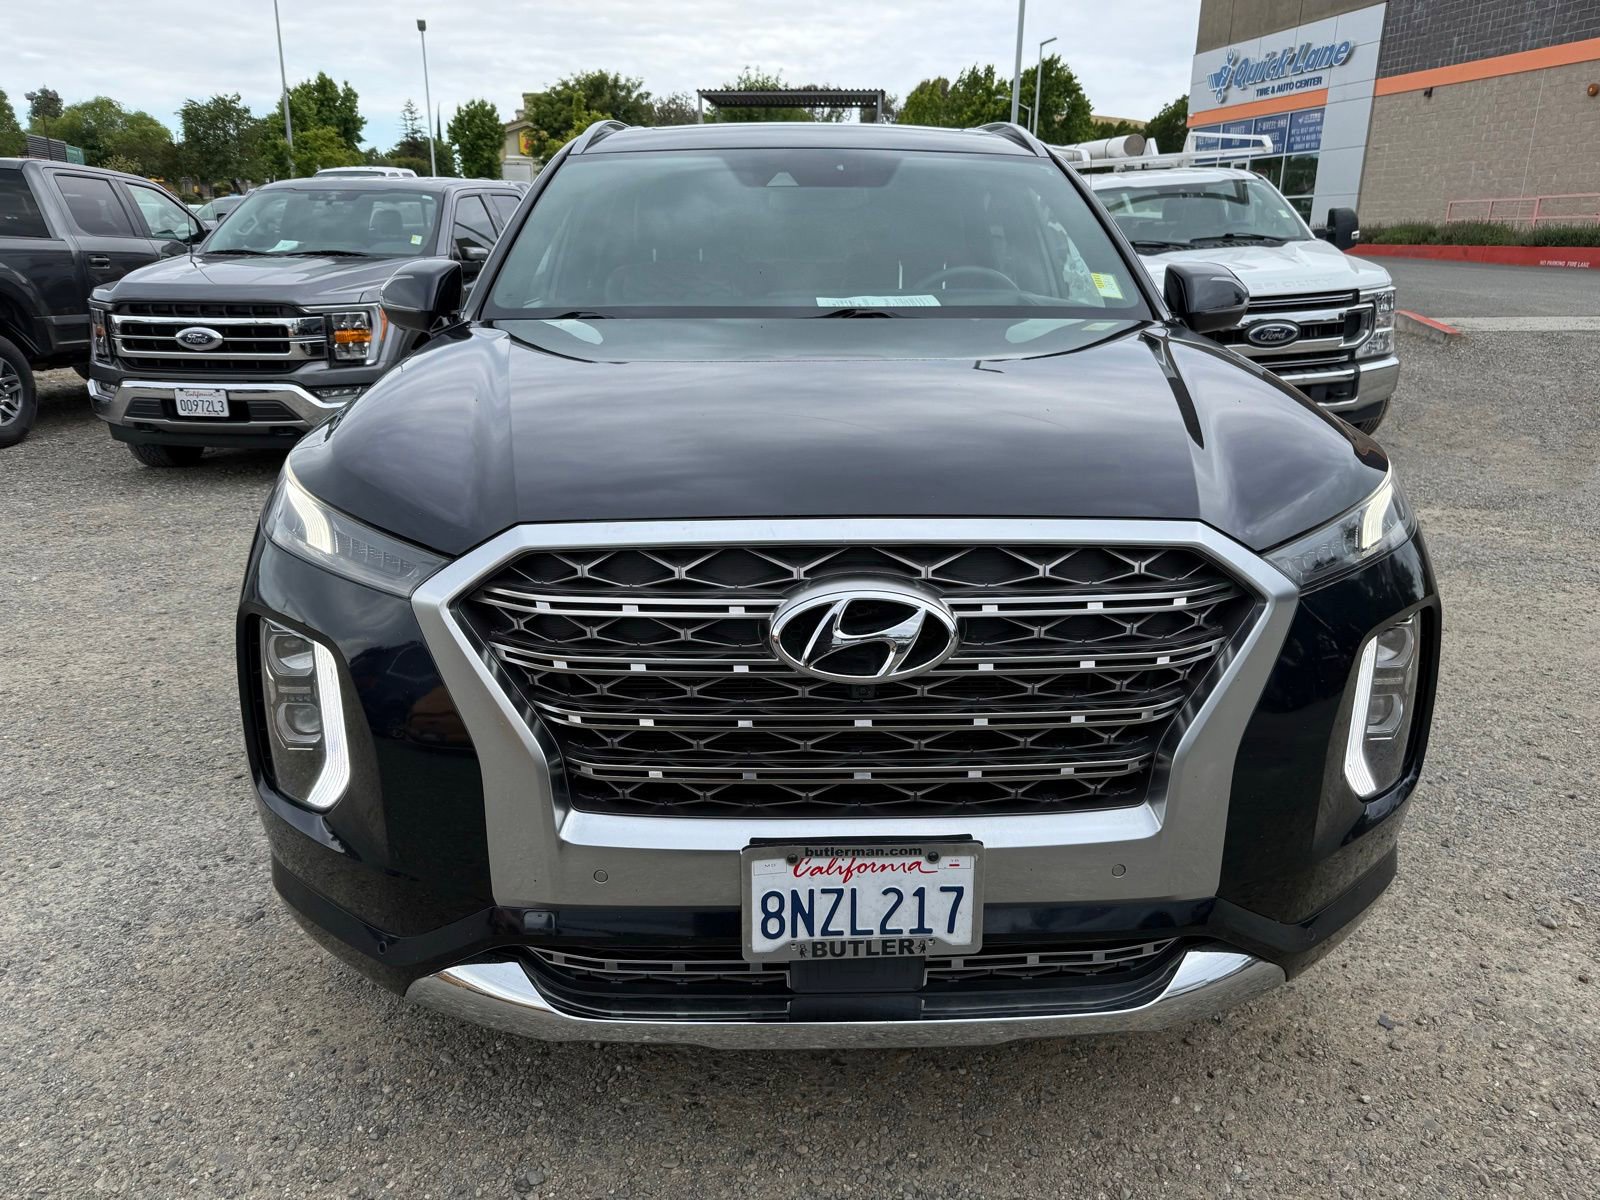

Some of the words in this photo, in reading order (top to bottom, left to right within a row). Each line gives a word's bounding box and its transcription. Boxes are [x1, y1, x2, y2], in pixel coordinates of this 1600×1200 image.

[1233, 48, 1290, 89] Quick
[1291, 40, 1352, 76] Lane
[1256, 86, 1270, 97] TIRE
[1276, 82, 1295, 93] AUTO
[1295, 76, 1323, 89] CENTER
[186, 333, 208, 344] Ford
[1260, 328, 1287, 340] Ford
[180, 399, 225, 413] 00972L3
[804, 846, 922, 857] butlerman.com
[793, 856, 939, 883] California
[760, 886, 965, 940] 8NZL217
[811, 939, 916, 958] BUTLER
